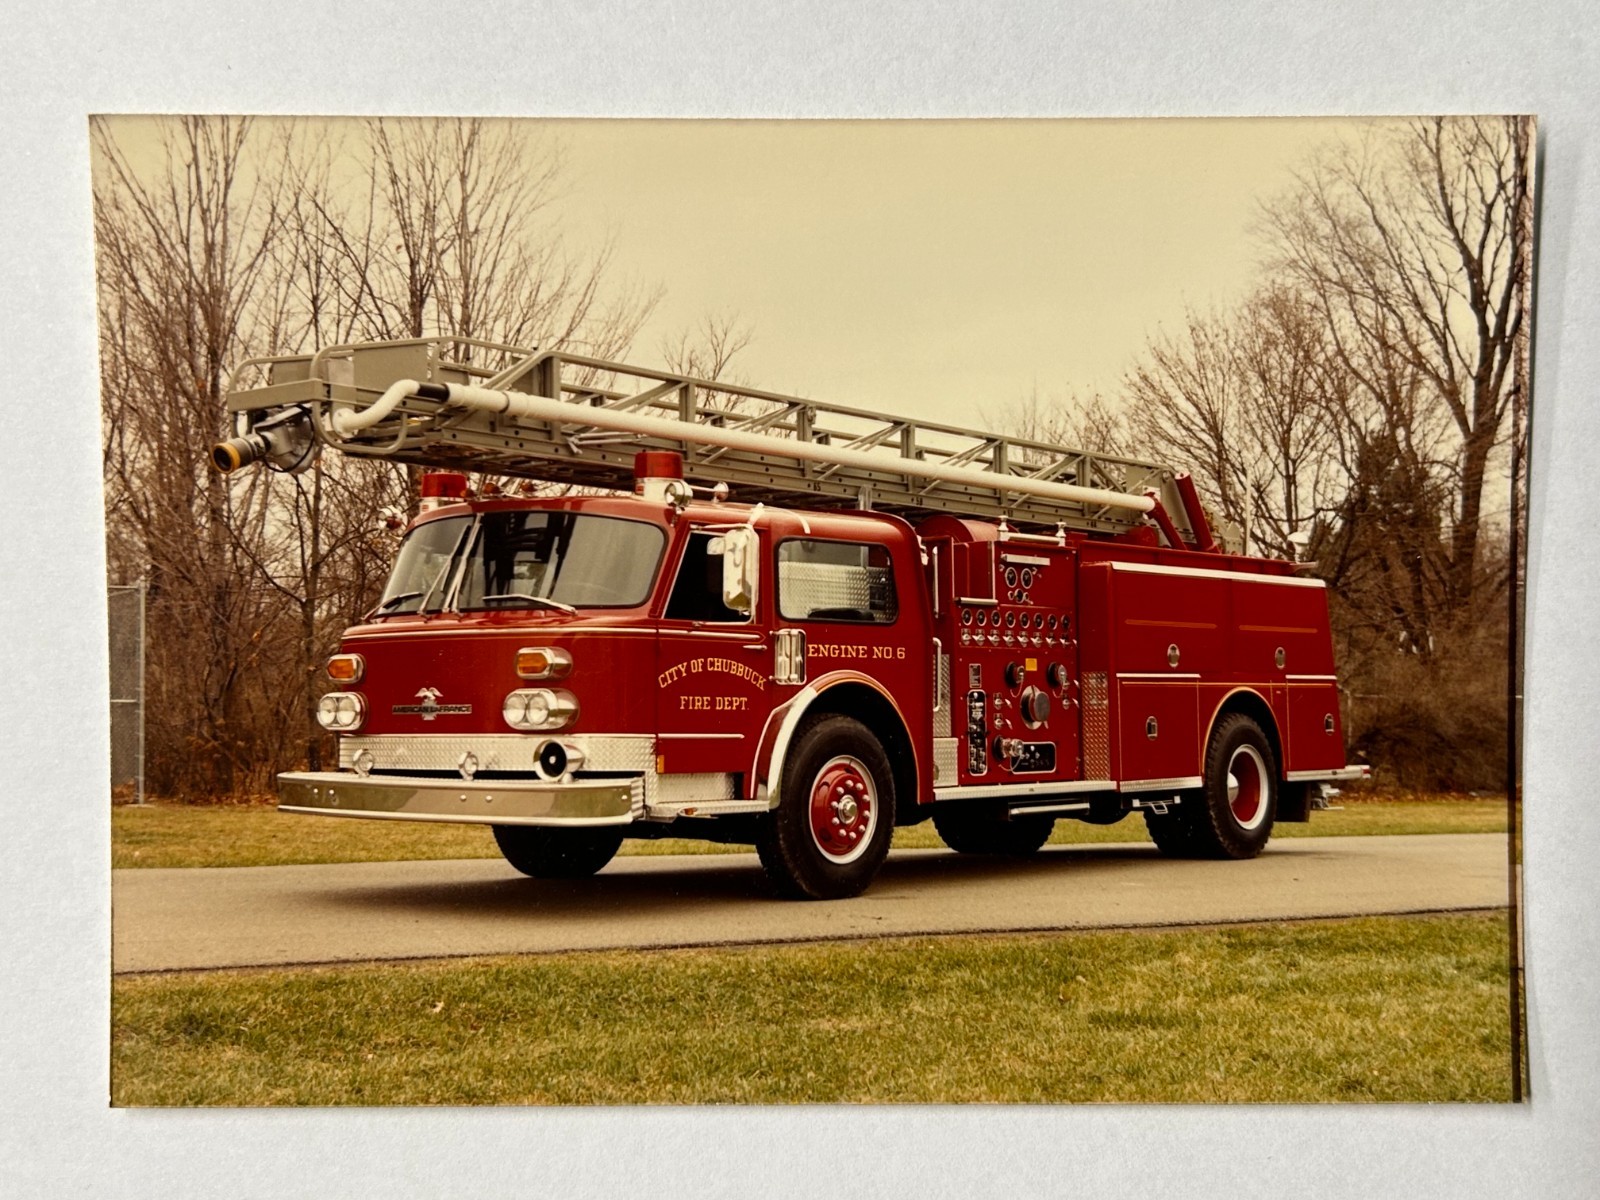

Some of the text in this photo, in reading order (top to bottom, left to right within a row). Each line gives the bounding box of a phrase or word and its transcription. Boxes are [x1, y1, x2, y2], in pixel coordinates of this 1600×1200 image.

[807, 644, 868, 658] ENGINE
[658, 657, 767, 691] CITY OF CHUBBUCK
[680, 696, 750, 711] FIRE DEPT.
